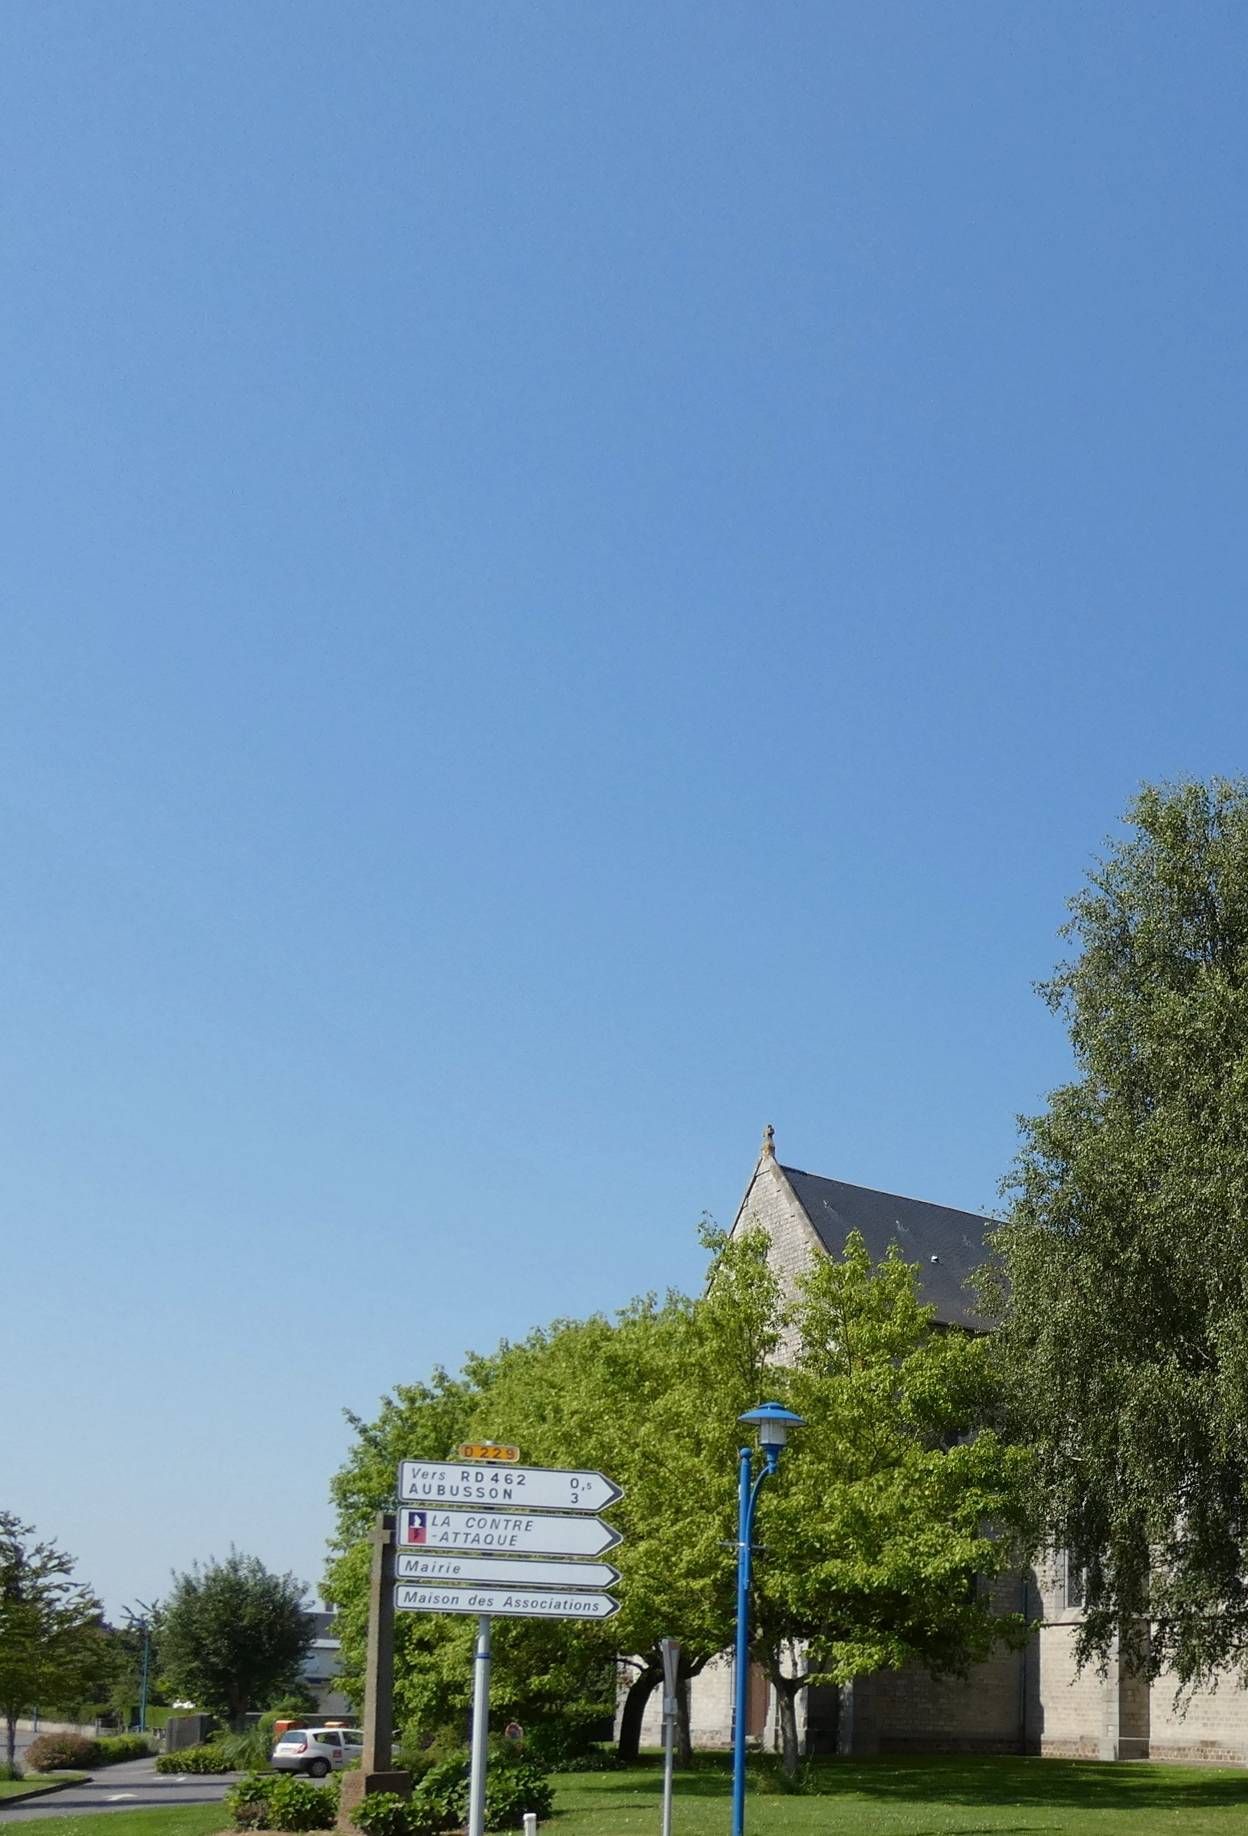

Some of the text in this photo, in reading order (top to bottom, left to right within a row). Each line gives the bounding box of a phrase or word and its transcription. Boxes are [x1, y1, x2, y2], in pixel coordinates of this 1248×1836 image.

[412, 1468, 446, 1481] Vers
[409, 1483, 513, 1500] AUBUSSON
[570, 1478, 592, 1491] 0,5
[570, 1493, 579, 1504] 3
[431, 1515, 534, 1532] LA CONTRE
[432, 1531, 518, 1547] -ATTAQUE
[405, 1560, 461, 1574] Mairie
[403, 1591, 600, 1612] Maison des Associations
